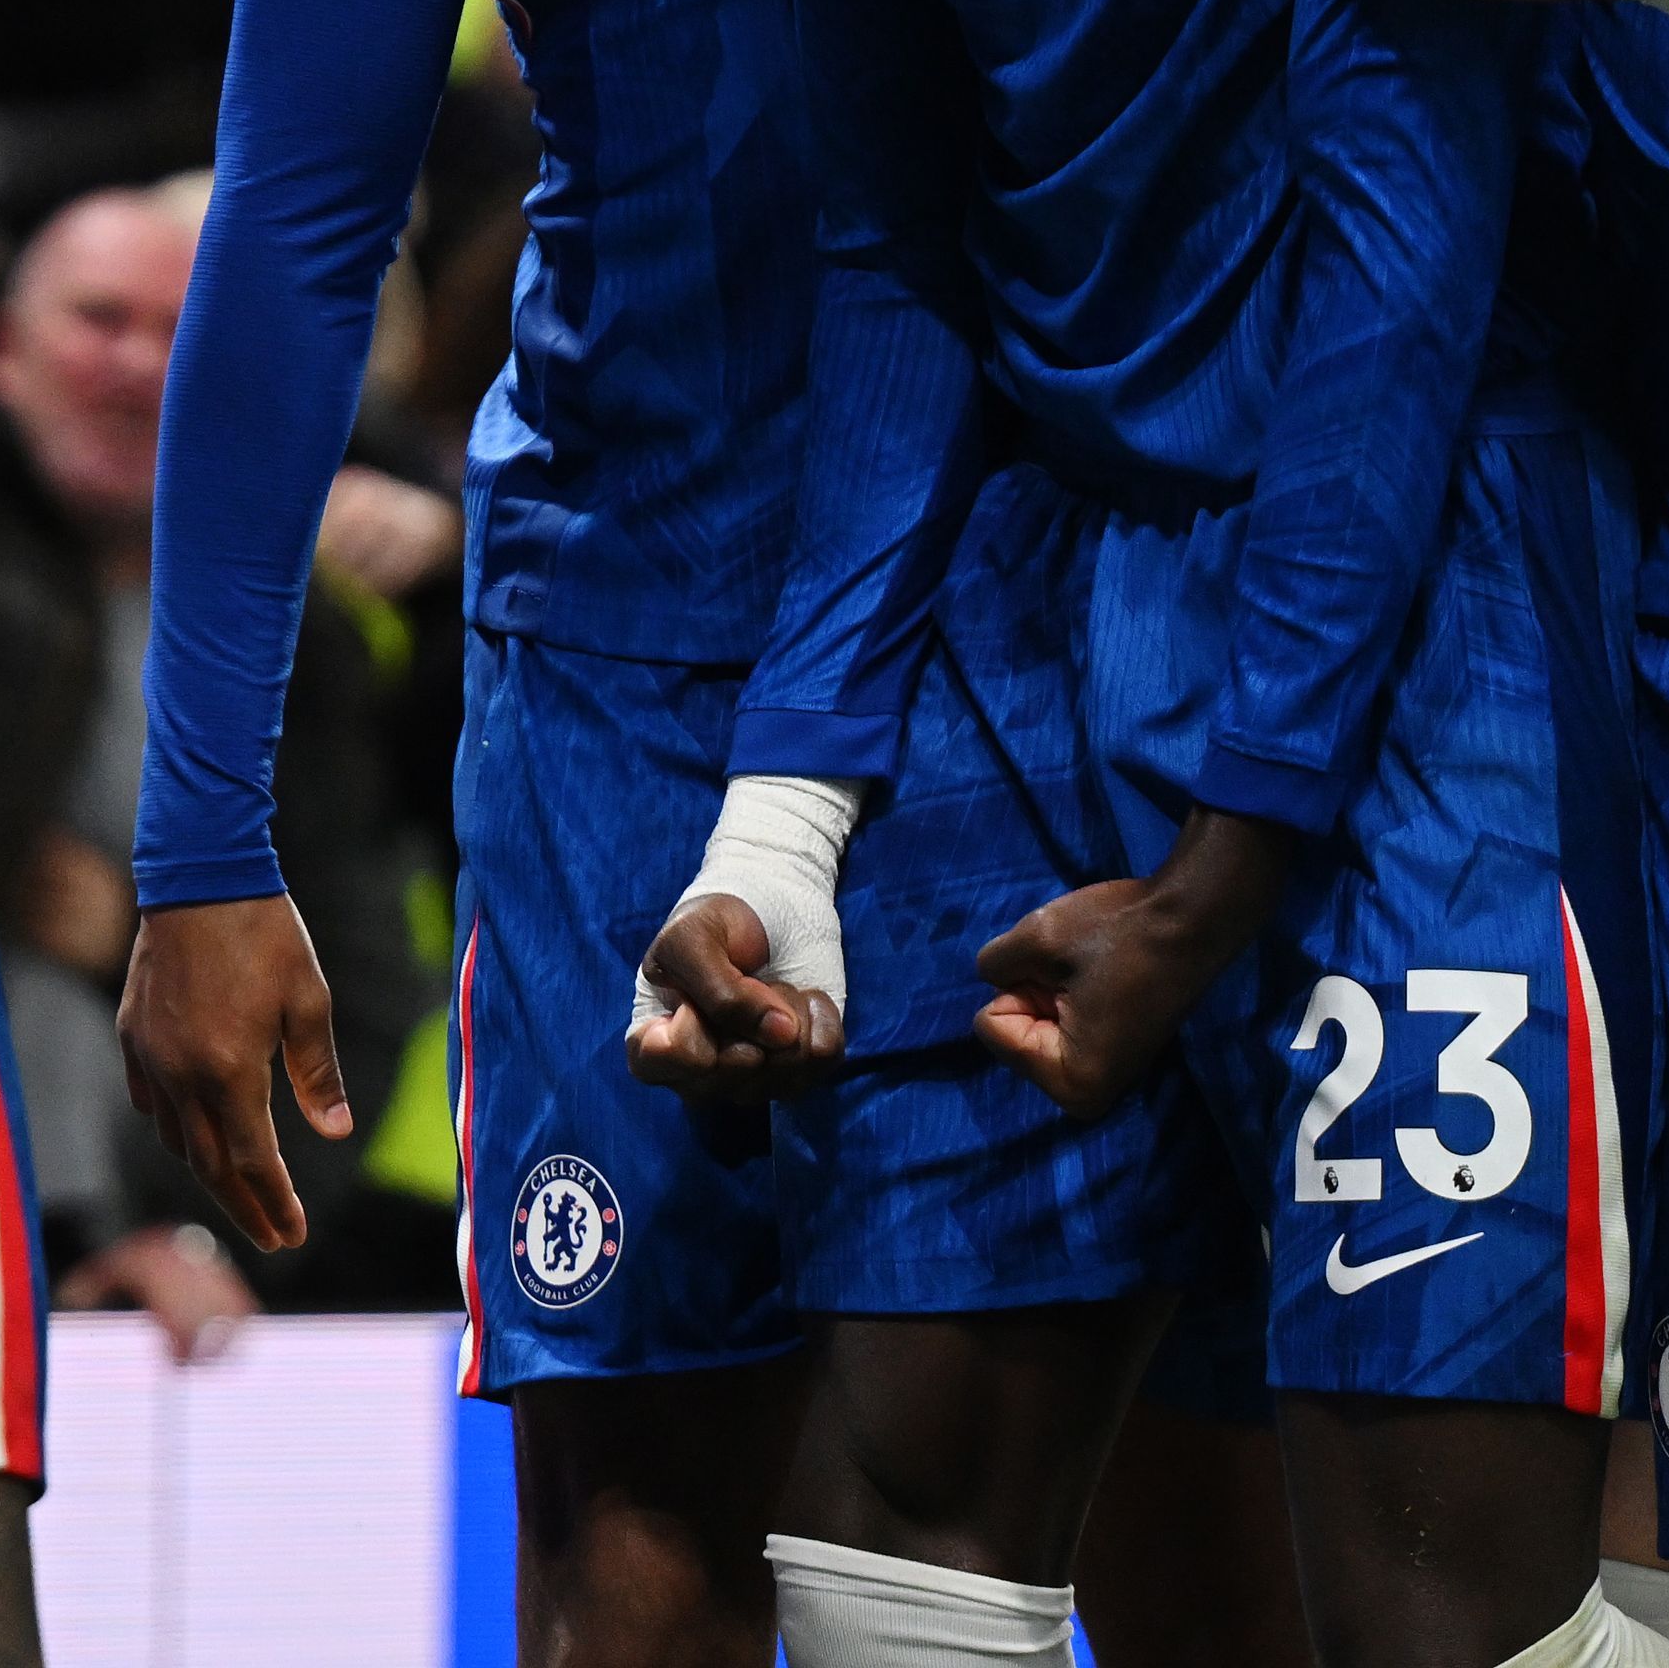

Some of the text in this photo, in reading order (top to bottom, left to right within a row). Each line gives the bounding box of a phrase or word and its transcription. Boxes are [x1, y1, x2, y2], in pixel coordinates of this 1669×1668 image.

[1289, 968, 1533, 1202] 23
[530, 1160, 597, 1193] CHELSEA
[522, 1273, 599, 1301] FOOTBALL CLUB
